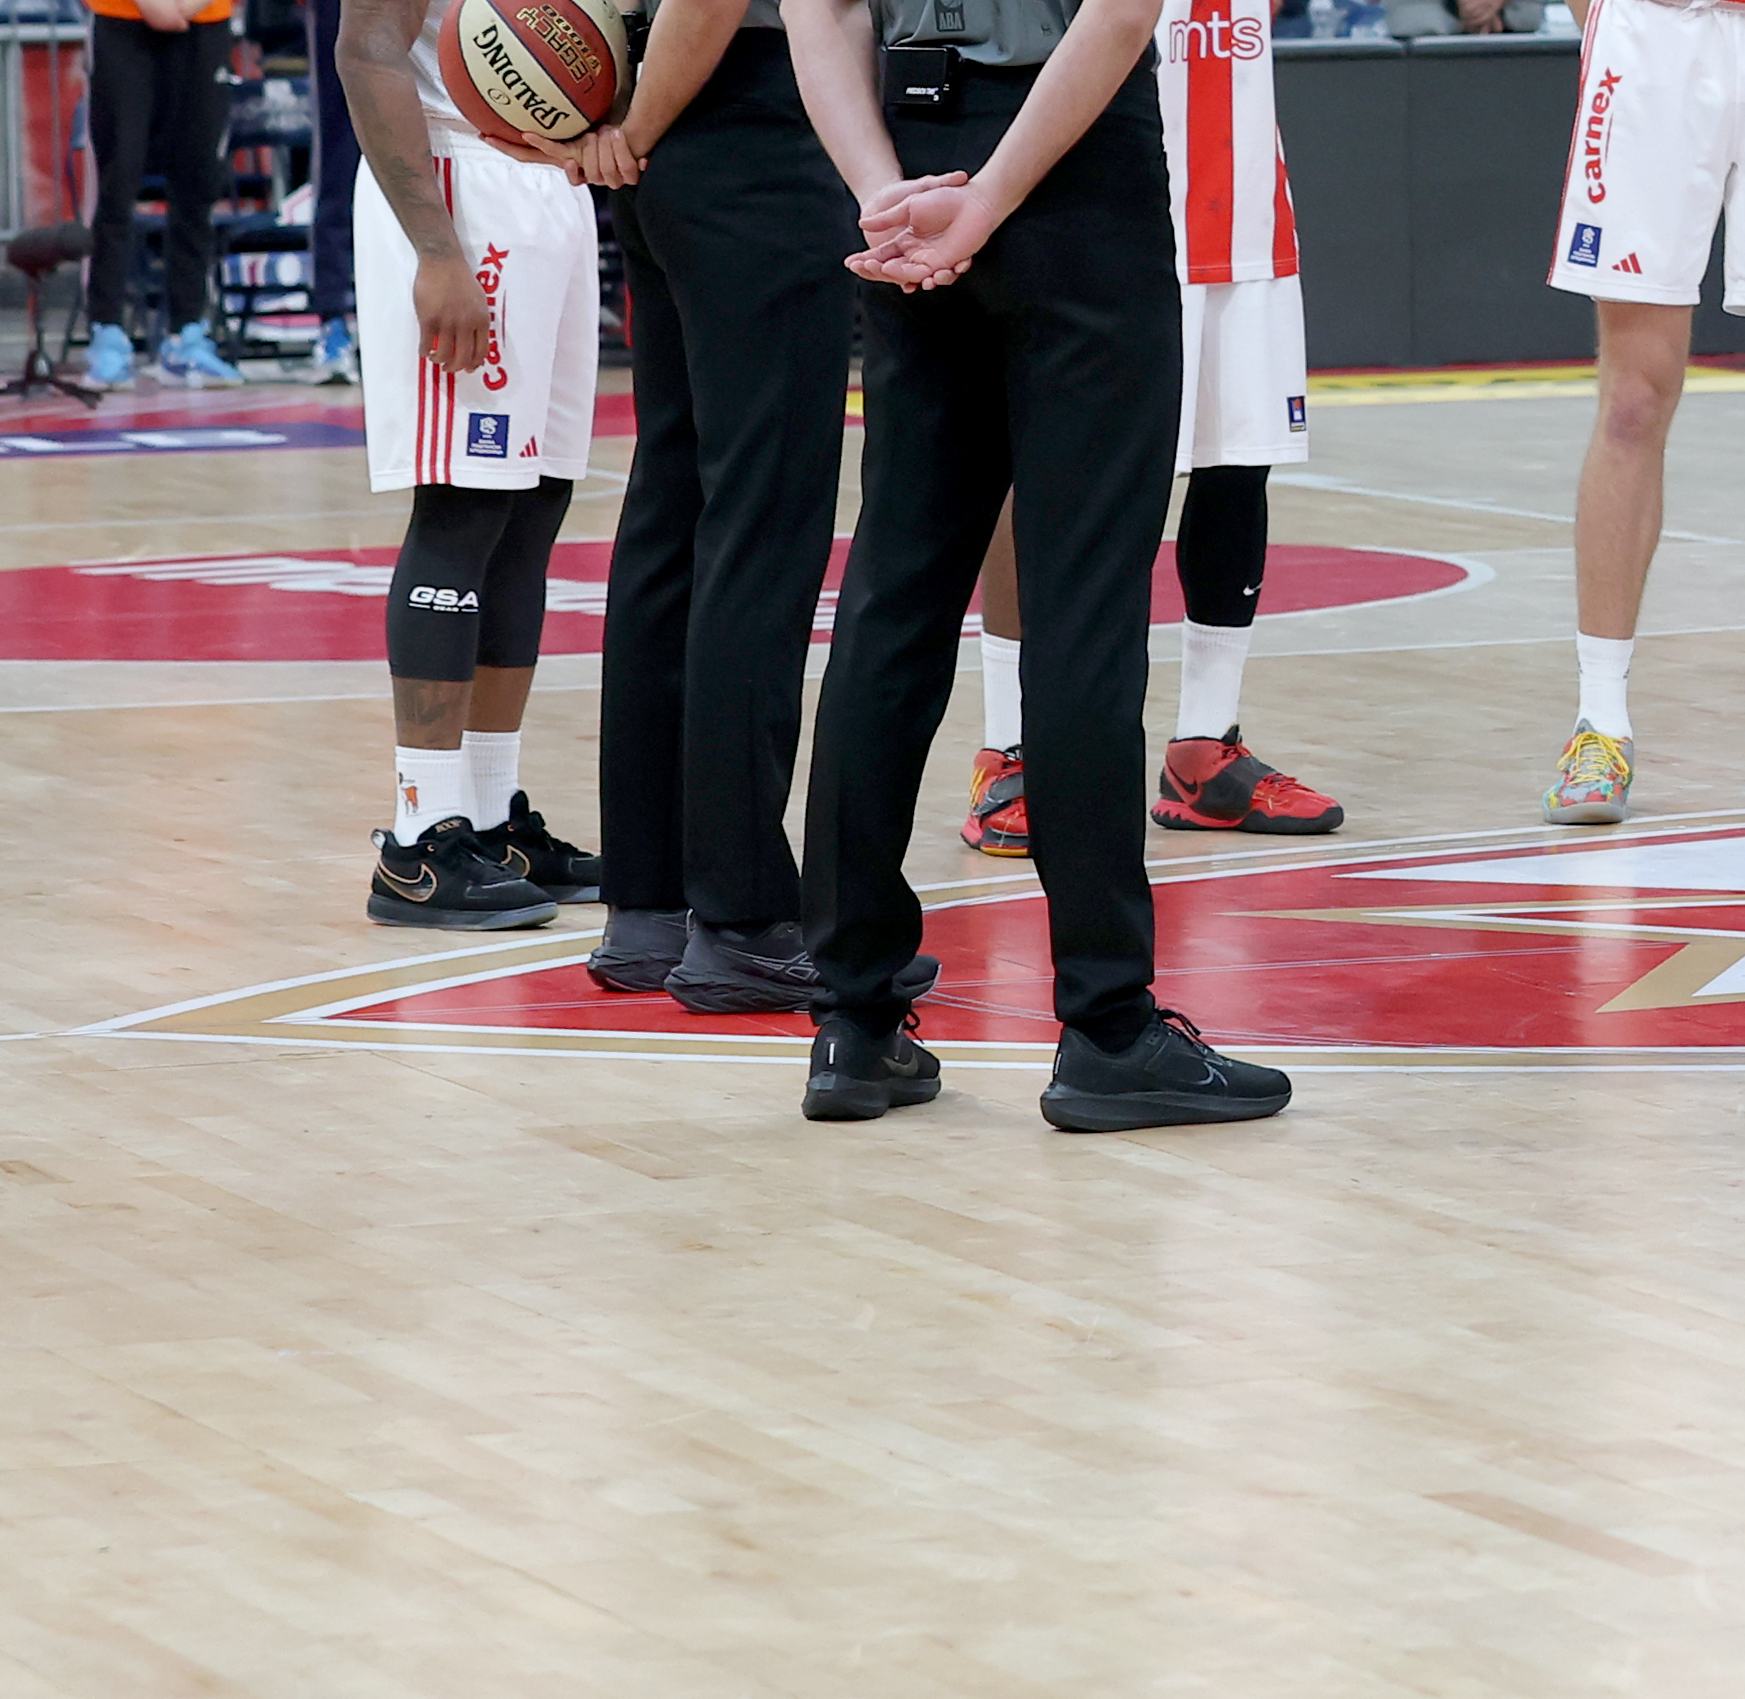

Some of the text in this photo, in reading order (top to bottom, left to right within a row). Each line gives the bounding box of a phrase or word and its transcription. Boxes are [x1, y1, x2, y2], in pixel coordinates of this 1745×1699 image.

[516, 7, 596, 94] LEGACY
[940, 12, 962, 30] ABA
[1169, 10, 1264, 64] mts
[473, 23, 571, 131] SPALDING
[1585, 66, 1623, 204] carnex
[409, 586, 479, 607] GSA
